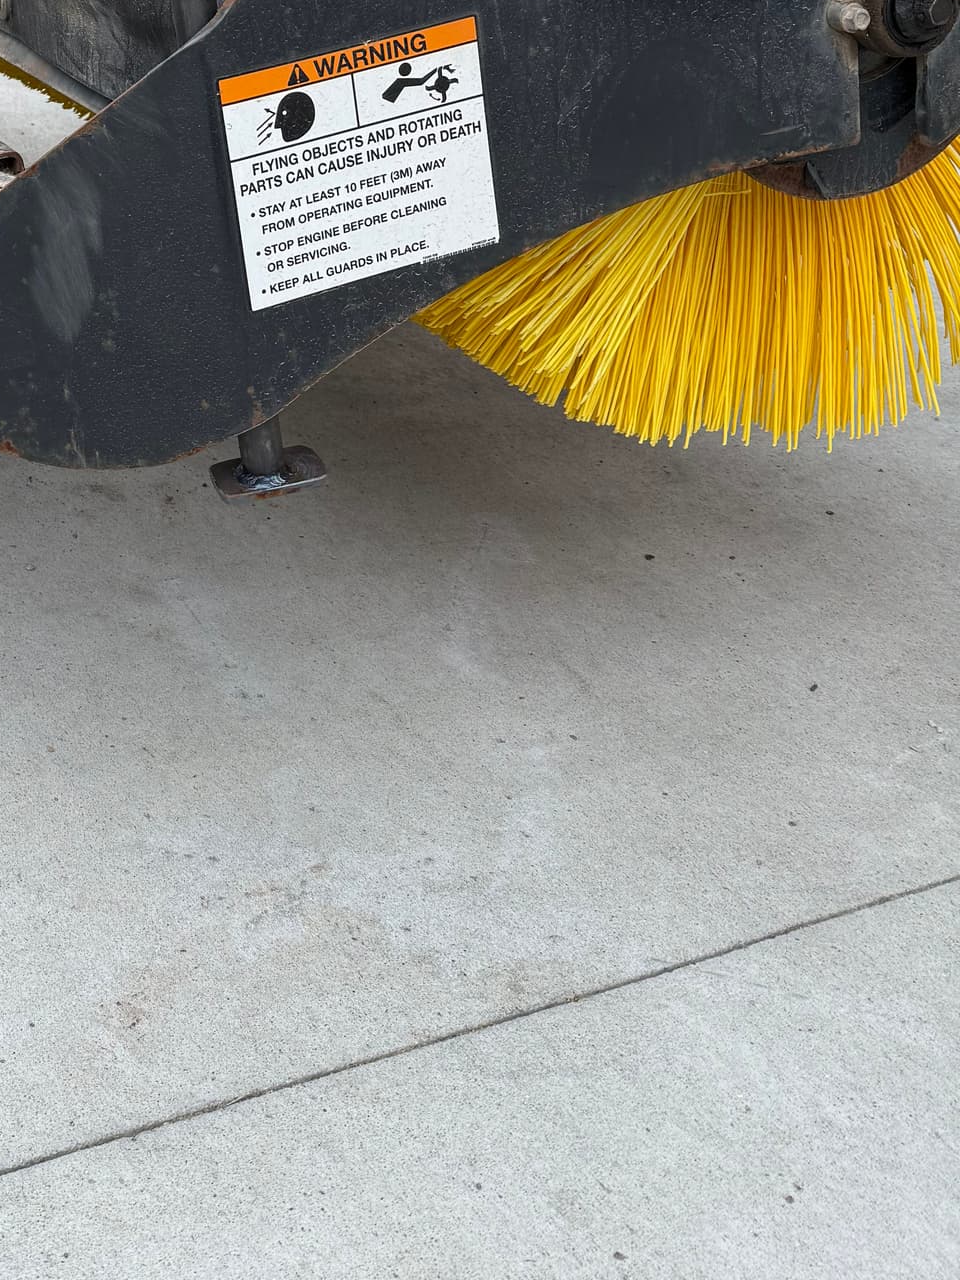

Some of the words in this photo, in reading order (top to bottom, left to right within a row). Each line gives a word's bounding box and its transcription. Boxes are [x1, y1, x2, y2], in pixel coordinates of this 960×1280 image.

[313, 33, 427, 78] WARNING
[239, 174, 283, 197] PARTS
[285, 165, 314, 184] CAN
[317, 152, 364, 175] CAUSE
[366, 138, 413, 162] INJURY
[417, 132, 437, 148] OR
[439, 120, 481, 142] DEATH
[251, 152, 299, 176] FLYING
[302, 135, 364, 162] OBJECTS
[367, 126, 395, 145] AND
[398, 108, 462, 136] ROTATING
[258, 201, 286, 218] STAY
[289, 196, 302, 210] AT
[305, 185, 341, 204] LEAST
[344, 182, 357, 193] 10
[359, 173, 387, 190] FEET
[390, 166, 413, 183] (3M)
[415, 157, 446, 174] AWAY
[261, 216, 295, 235] FROM
[298, 198, 363, 224] OPERATING
[365, 178, 434, 205] EQUIPMENT.
[264, 239, 294, 256] STOP
[296, 226, 340, 247] ENGINE
[342, 212, 388, 234] BEFORE
[390, 196, 447, 220] CLEANING
[267, 259, 284, 273] OR
[286, 241, 351, 267] SERVICING.
[269, 277, 299, 294] KEEP
[302, 270, 324, 284] ALL
[326, 255, 373, 277] GUARDS
[375, 250, 387, 262] IN
[390, 239, 429, 258] PLACE.
